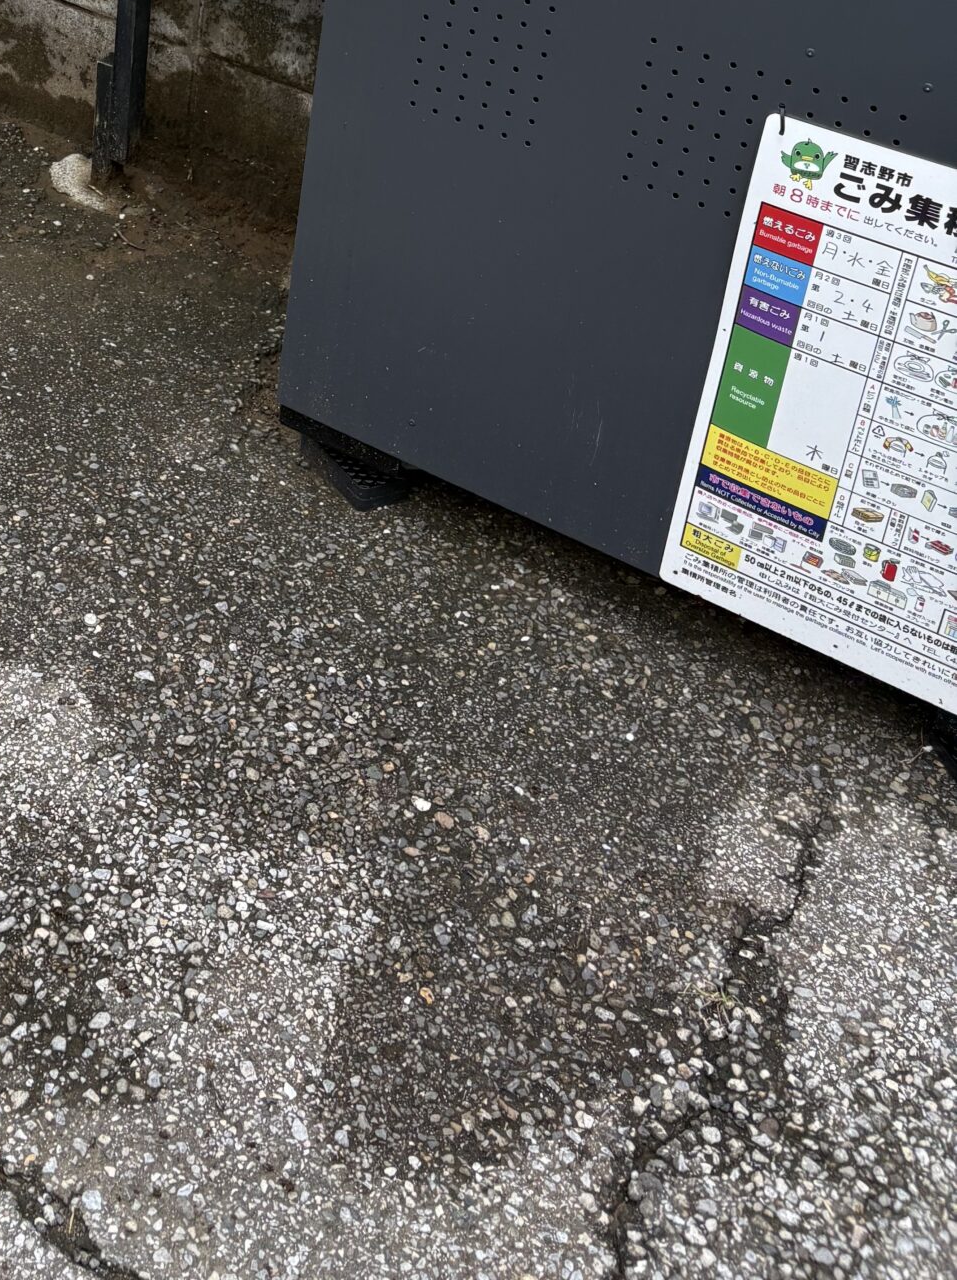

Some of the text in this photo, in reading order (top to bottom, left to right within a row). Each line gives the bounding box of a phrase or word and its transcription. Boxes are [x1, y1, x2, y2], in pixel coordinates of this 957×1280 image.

[843, 154, 913, 188] 習志野市
[762, 216, 815, 241] 燃えるごみ
[825, 229, 851, 243] 週3回
[759, 229, 812, 253] Burnable garbage
[753, 254, 805, 279] 燃えないごみ
[752, 275, 779, 290] garbage
[754, 267, 799, 289] Non-Burnable
[814, 271, 840, 286] 月2回
[871, 277, 889, 289] 曜日
[749, 296, 789, 319] 有害ごみ
[740, 308, 792, 335] Hazardous waste
[804, 312, 829, 327] 月1回
[860, 319, 877, 331] 曜日
[793, 352, 818, 367] 週1回
[849, 360, 866, 371] 曜日
[733, 362, 773, 386] 資源物
[729, 393, 756, 408] resource
[731, 385, 764, 405] Recyclable
[821, 463, 837, 474] 曜日
[715, 487, 729, 497] NOT
[730, 494, 756, 510] Collected
[763, 509, 789, 524] Accepted
[789, 520, 797, 528] by
[808, 528, 819, 538] City
[692, 528, 733, 552] 粗大ごみ
[921, 643, 939, 657] TEL
